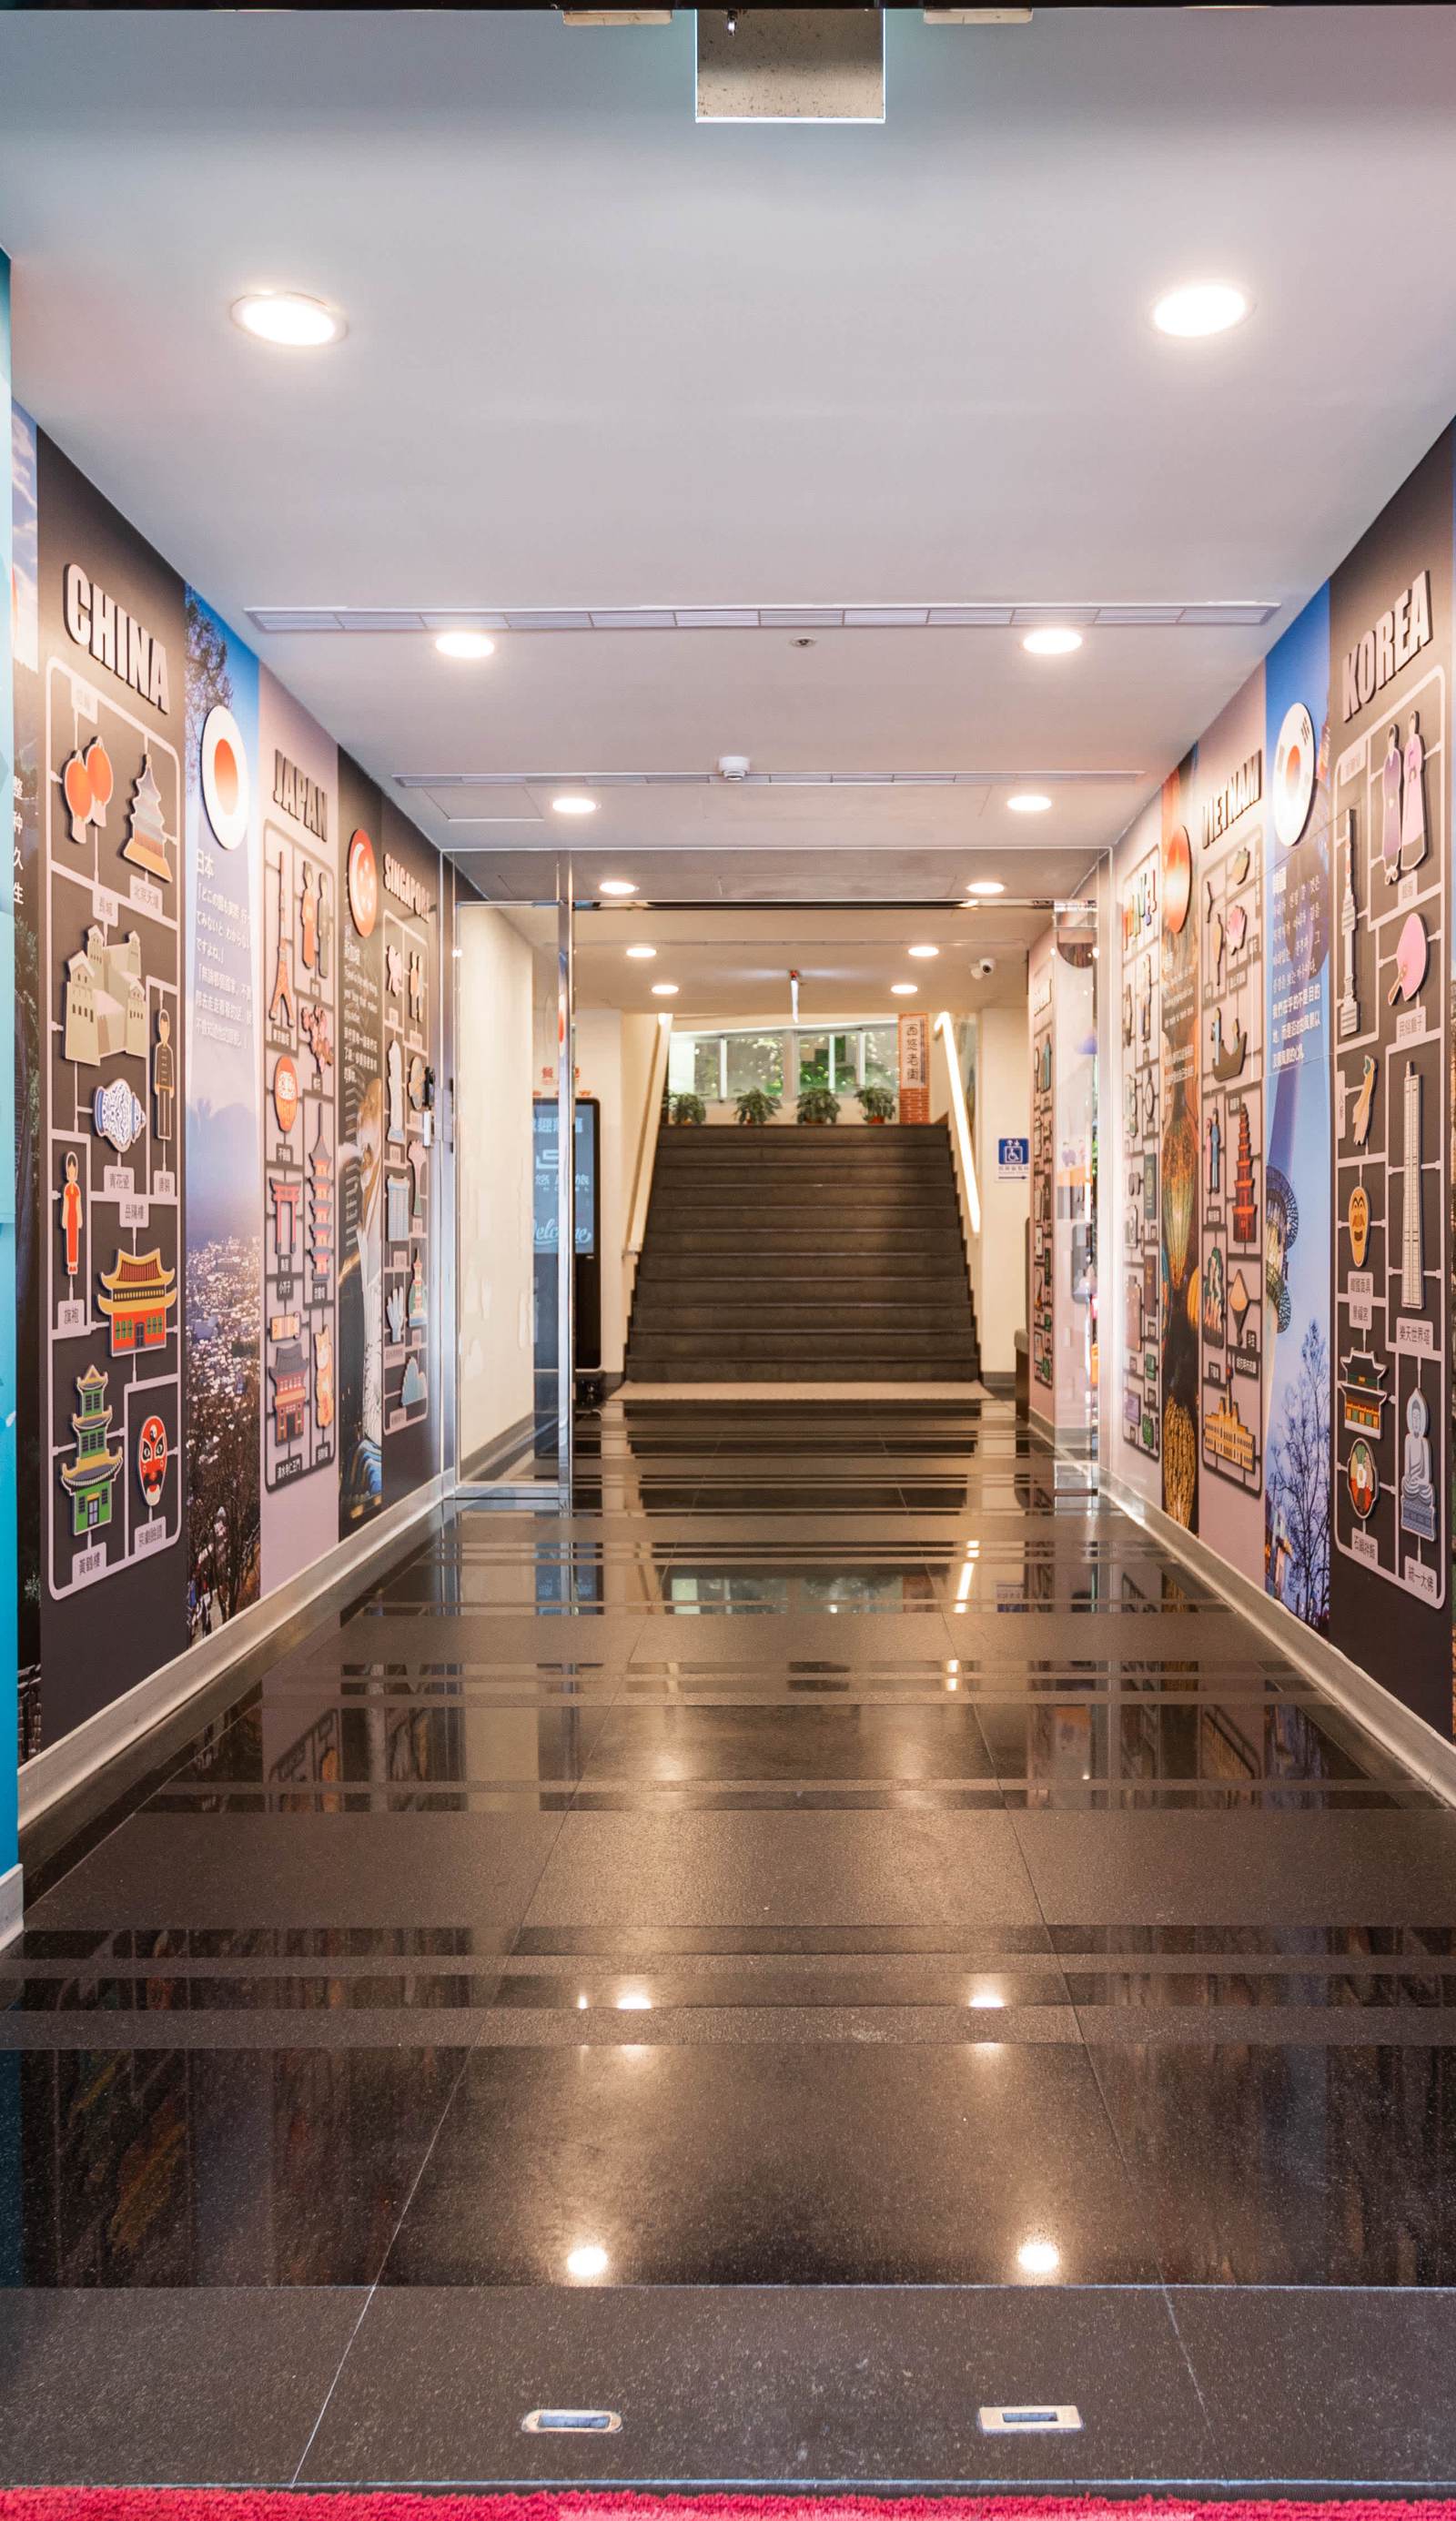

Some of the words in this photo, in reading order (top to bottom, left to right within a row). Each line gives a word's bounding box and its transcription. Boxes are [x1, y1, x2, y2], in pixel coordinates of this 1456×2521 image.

[62, 562, 170, 714] CHINA
[1342, 571, 1432, 724] KOREA
[272, 749, 328, 842] JAPAN
[1202, 749, 1260, 849] VIETNAM
[13, 845, 24, 870] 久
[13, 881, 24, 905] 生
[197, 848, 214, 878] 日本
[383, 853, 430, 923] SINGAPORE
